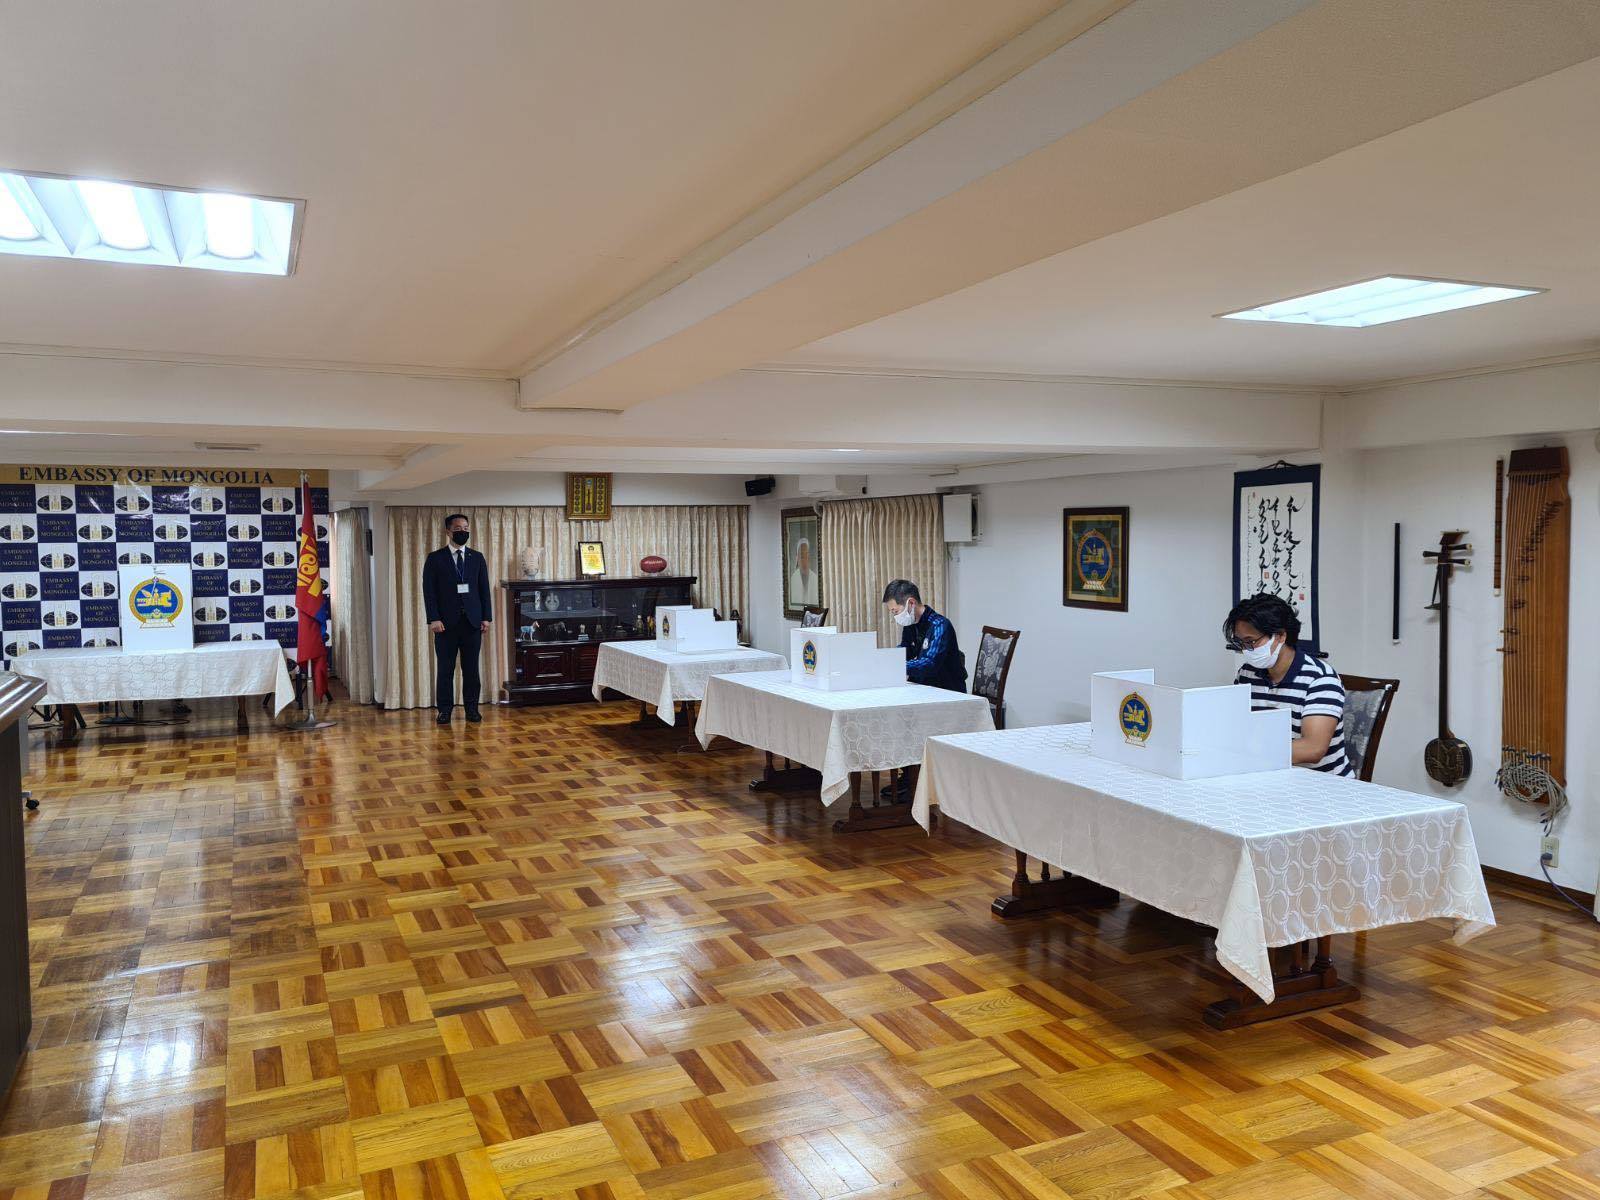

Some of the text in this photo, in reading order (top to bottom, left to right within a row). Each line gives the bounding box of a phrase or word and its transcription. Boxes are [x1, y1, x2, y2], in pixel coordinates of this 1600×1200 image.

[19, 466, 274, 485] EMBASSY OF MONGOLIA
